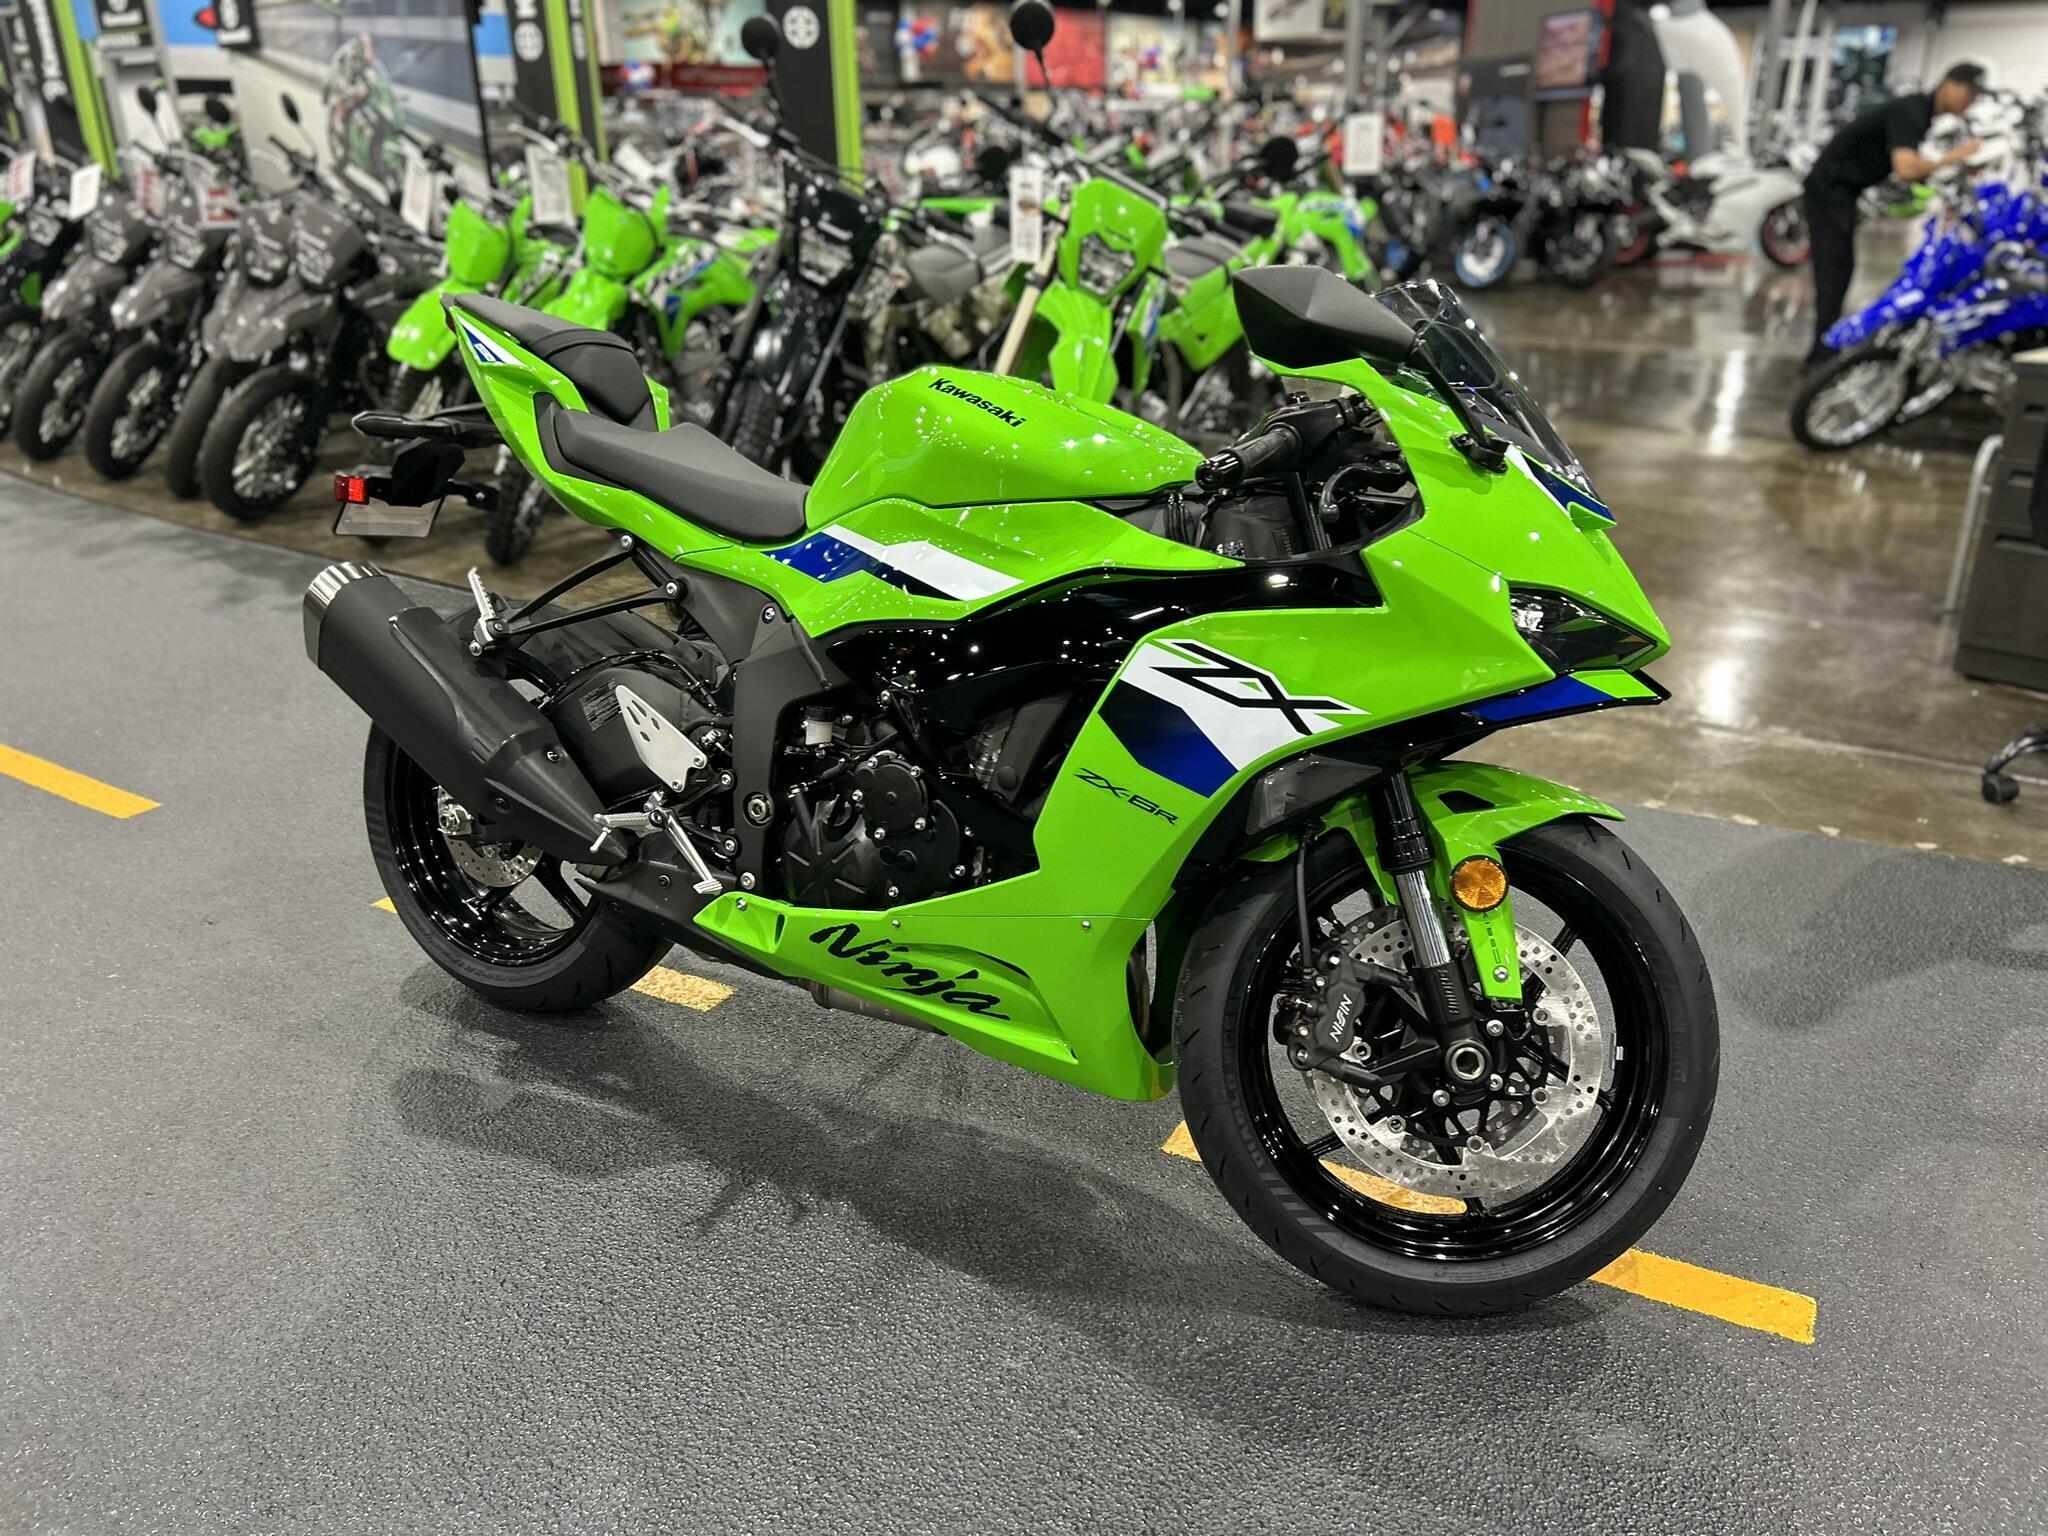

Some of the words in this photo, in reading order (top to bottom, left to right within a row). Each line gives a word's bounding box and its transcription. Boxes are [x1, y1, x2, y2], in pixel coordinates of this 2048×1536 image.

[928, 378, 1026, 427] Kawasaki
[1149, 642, 1351, 735] ZX
[1073, 767, 1178, 825] ZX-6R
[809, 923, 1010, 1021] Ninja
